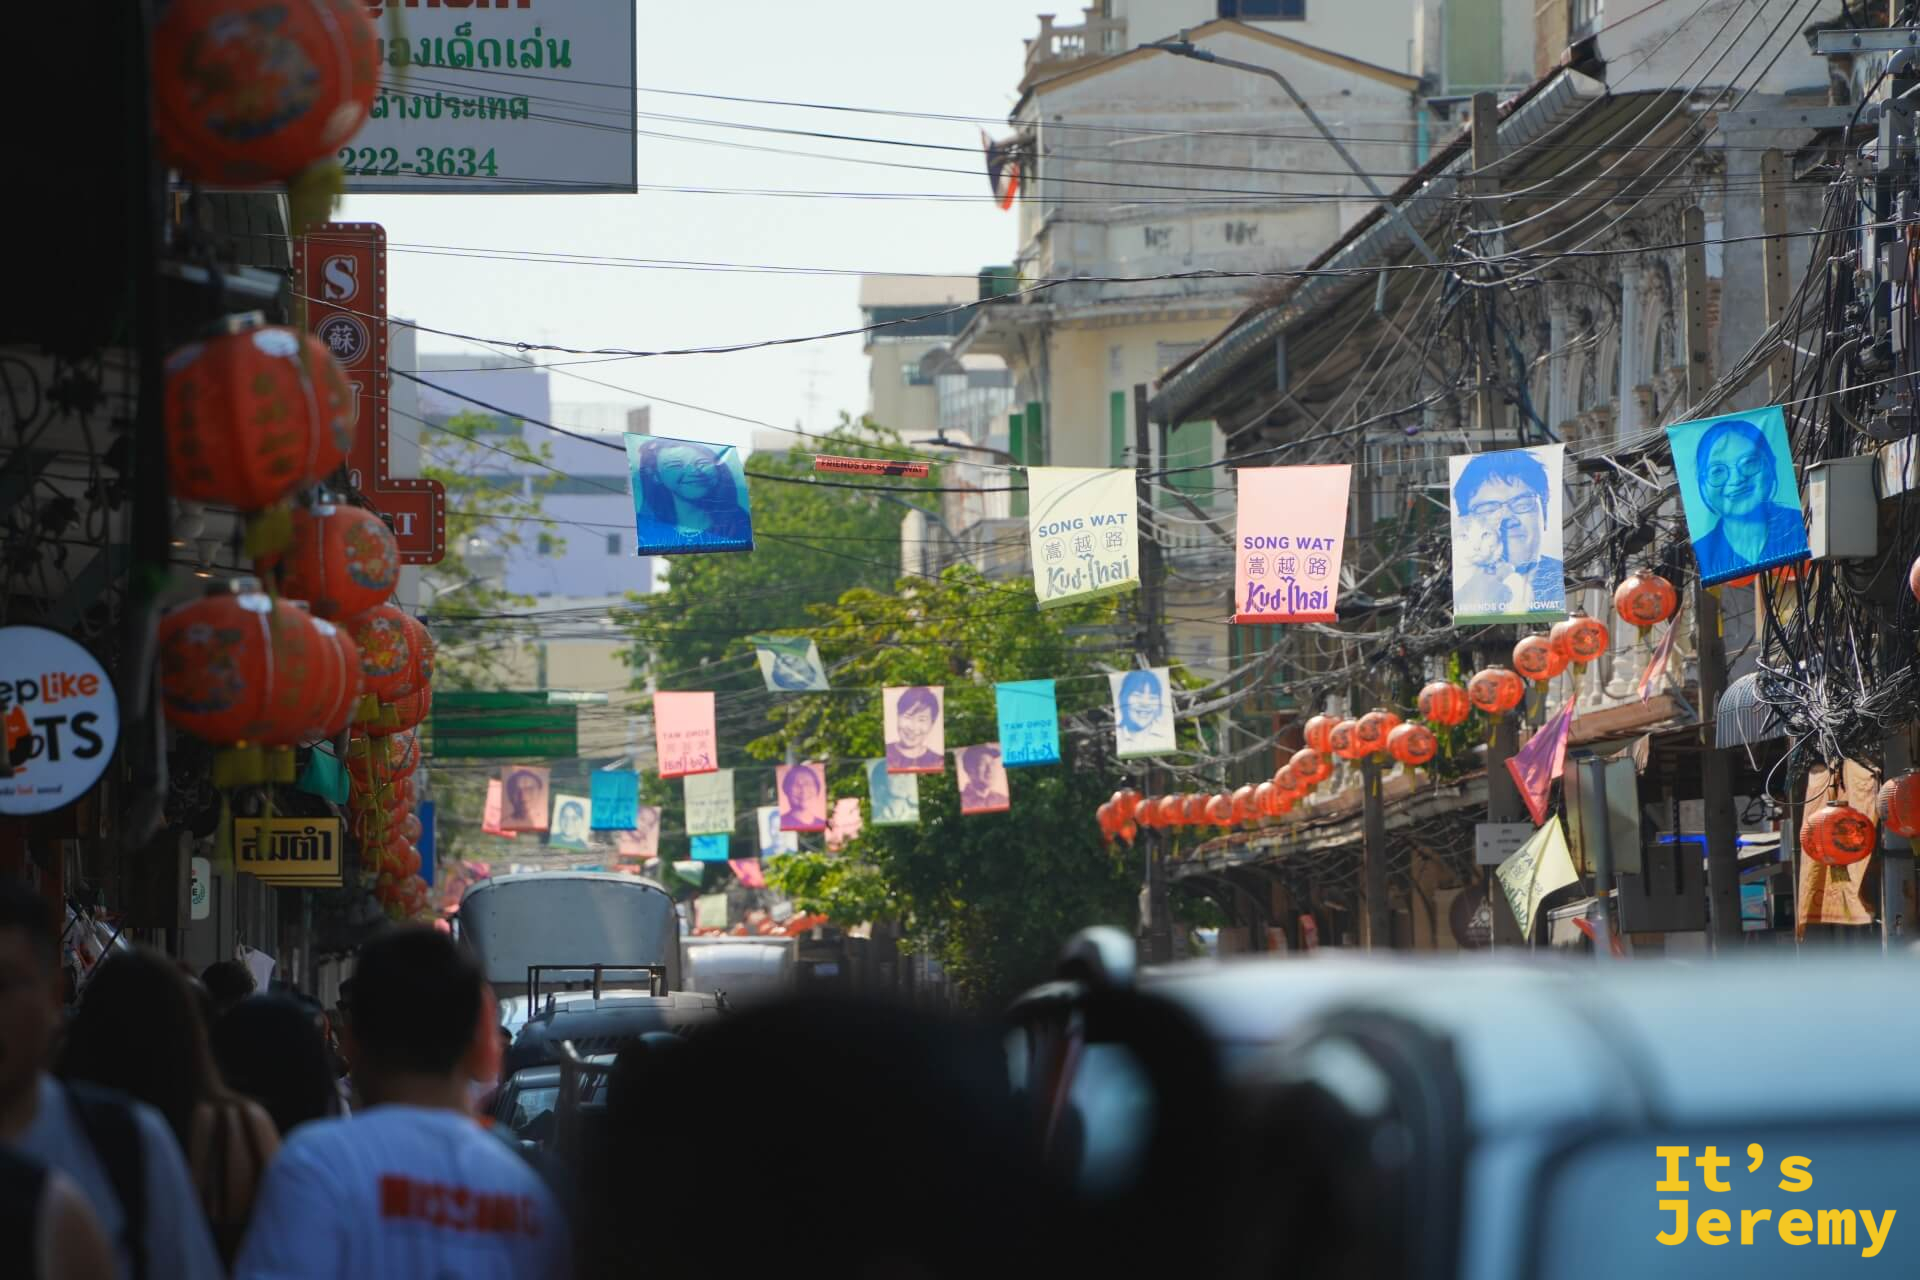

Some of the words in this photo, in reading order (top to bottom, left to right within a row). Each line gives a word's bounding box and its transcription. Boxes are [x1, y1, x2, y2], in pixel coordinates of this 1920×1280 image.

[376, 22, 572, 69] องเด็กเล่น
[368, 88, 530, 120] ต่างประเทศ
[337, 147, 499, 177] 222-3634
[1038, 518, 1084, 538] SONG
[1090, 513, 1128, 527] WAT
[1243, 536, 1290, 550] SONG
[1296, 537, 1335, 551] WAT
[241, 825, 331, 861] สมตำ
